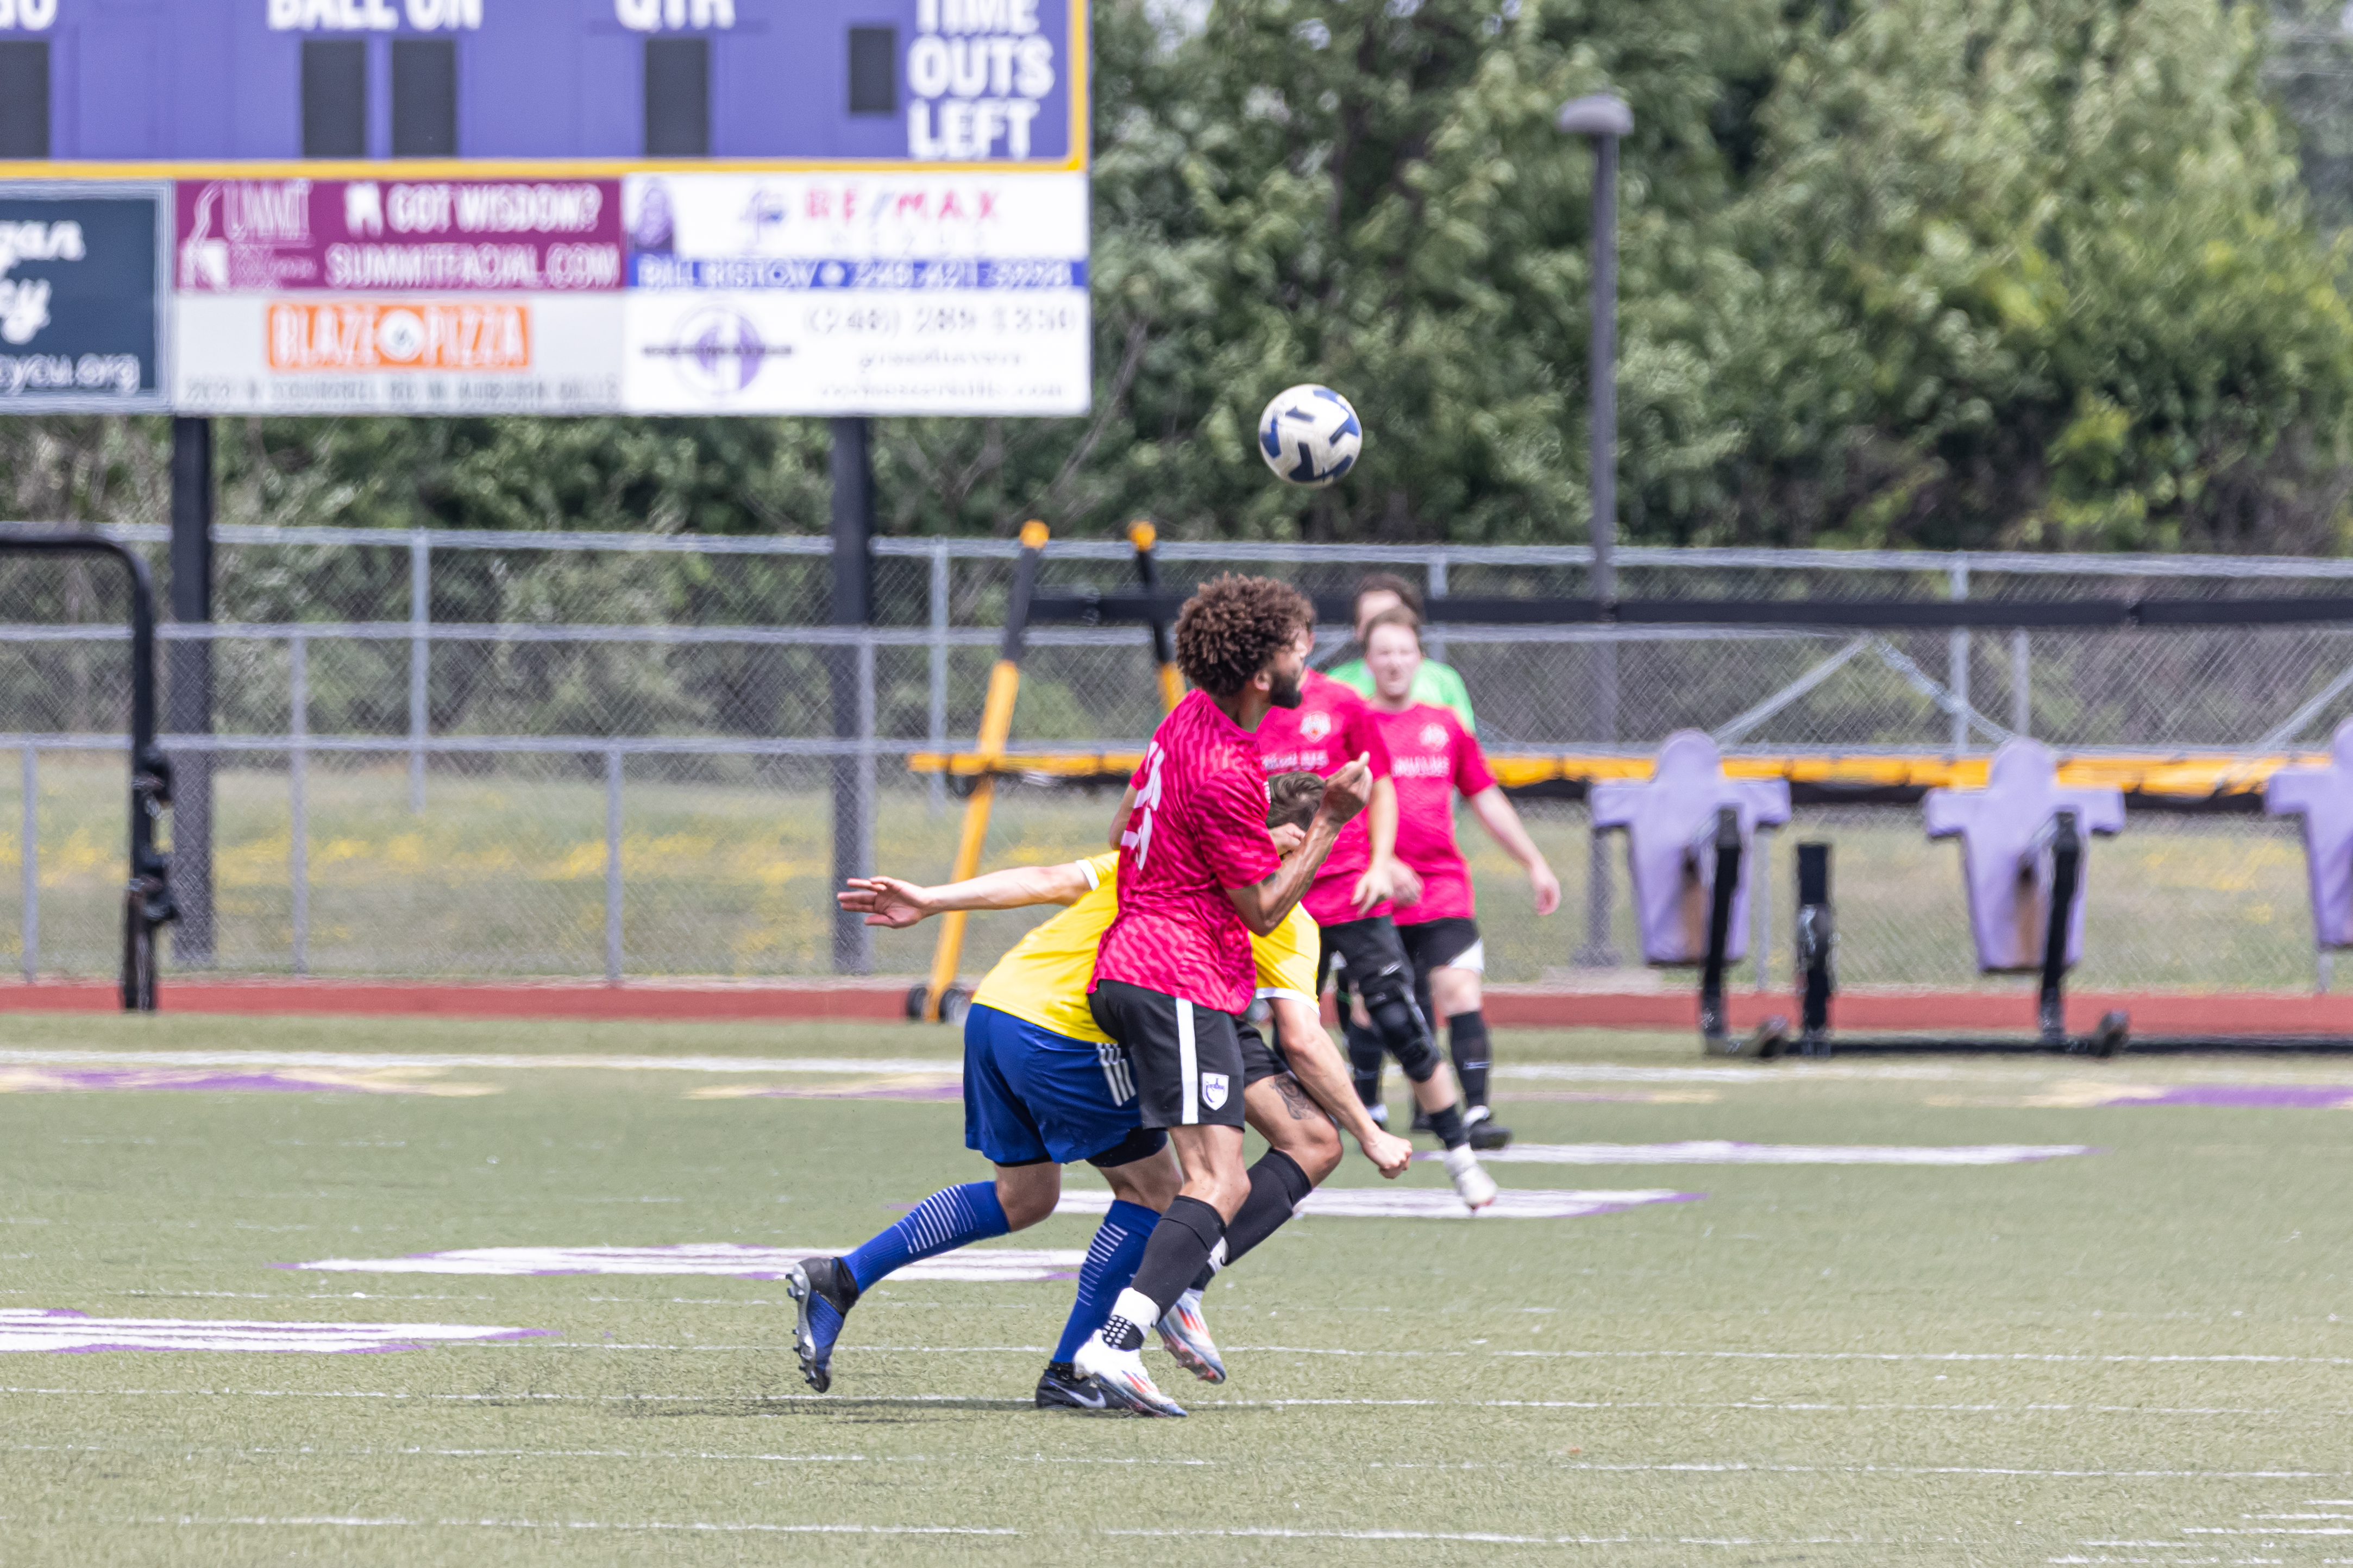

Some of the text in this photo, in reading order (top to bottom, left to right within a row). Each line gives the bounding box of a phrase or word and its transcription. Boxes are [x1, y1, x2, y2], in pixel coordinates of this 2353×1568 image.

[915, 0, 1040, 34] TIME
[908, 34, 1055, 98] OUTS
[908, 98, 1040, 159] LEFT
[387, 184, 451, 232] GOT
[805, 187, 1001, 224] RE/MAX
[274, 304, 528, 367] BLAZE PIZZA
